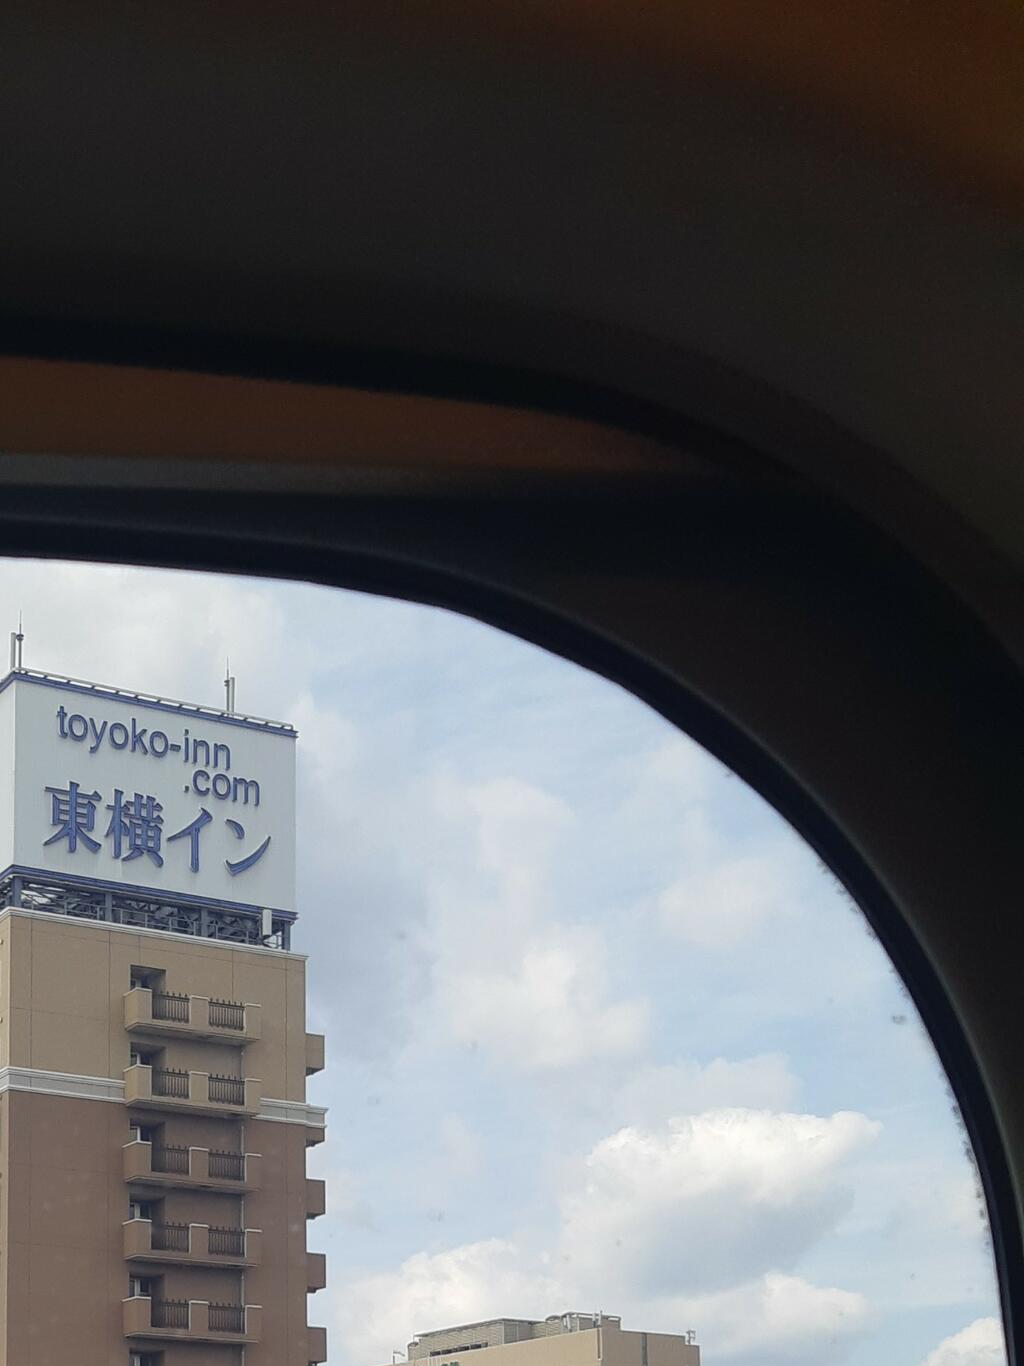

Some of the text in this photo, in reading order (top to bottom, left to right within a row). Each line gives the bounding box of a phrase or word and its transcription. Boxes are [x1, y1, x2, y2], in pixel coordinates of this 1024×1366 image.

[56, 703, 232, 770] toyoko-inn
[182, 766, 261, 807] .com
[43, 780, 272, 877] 東横イン
